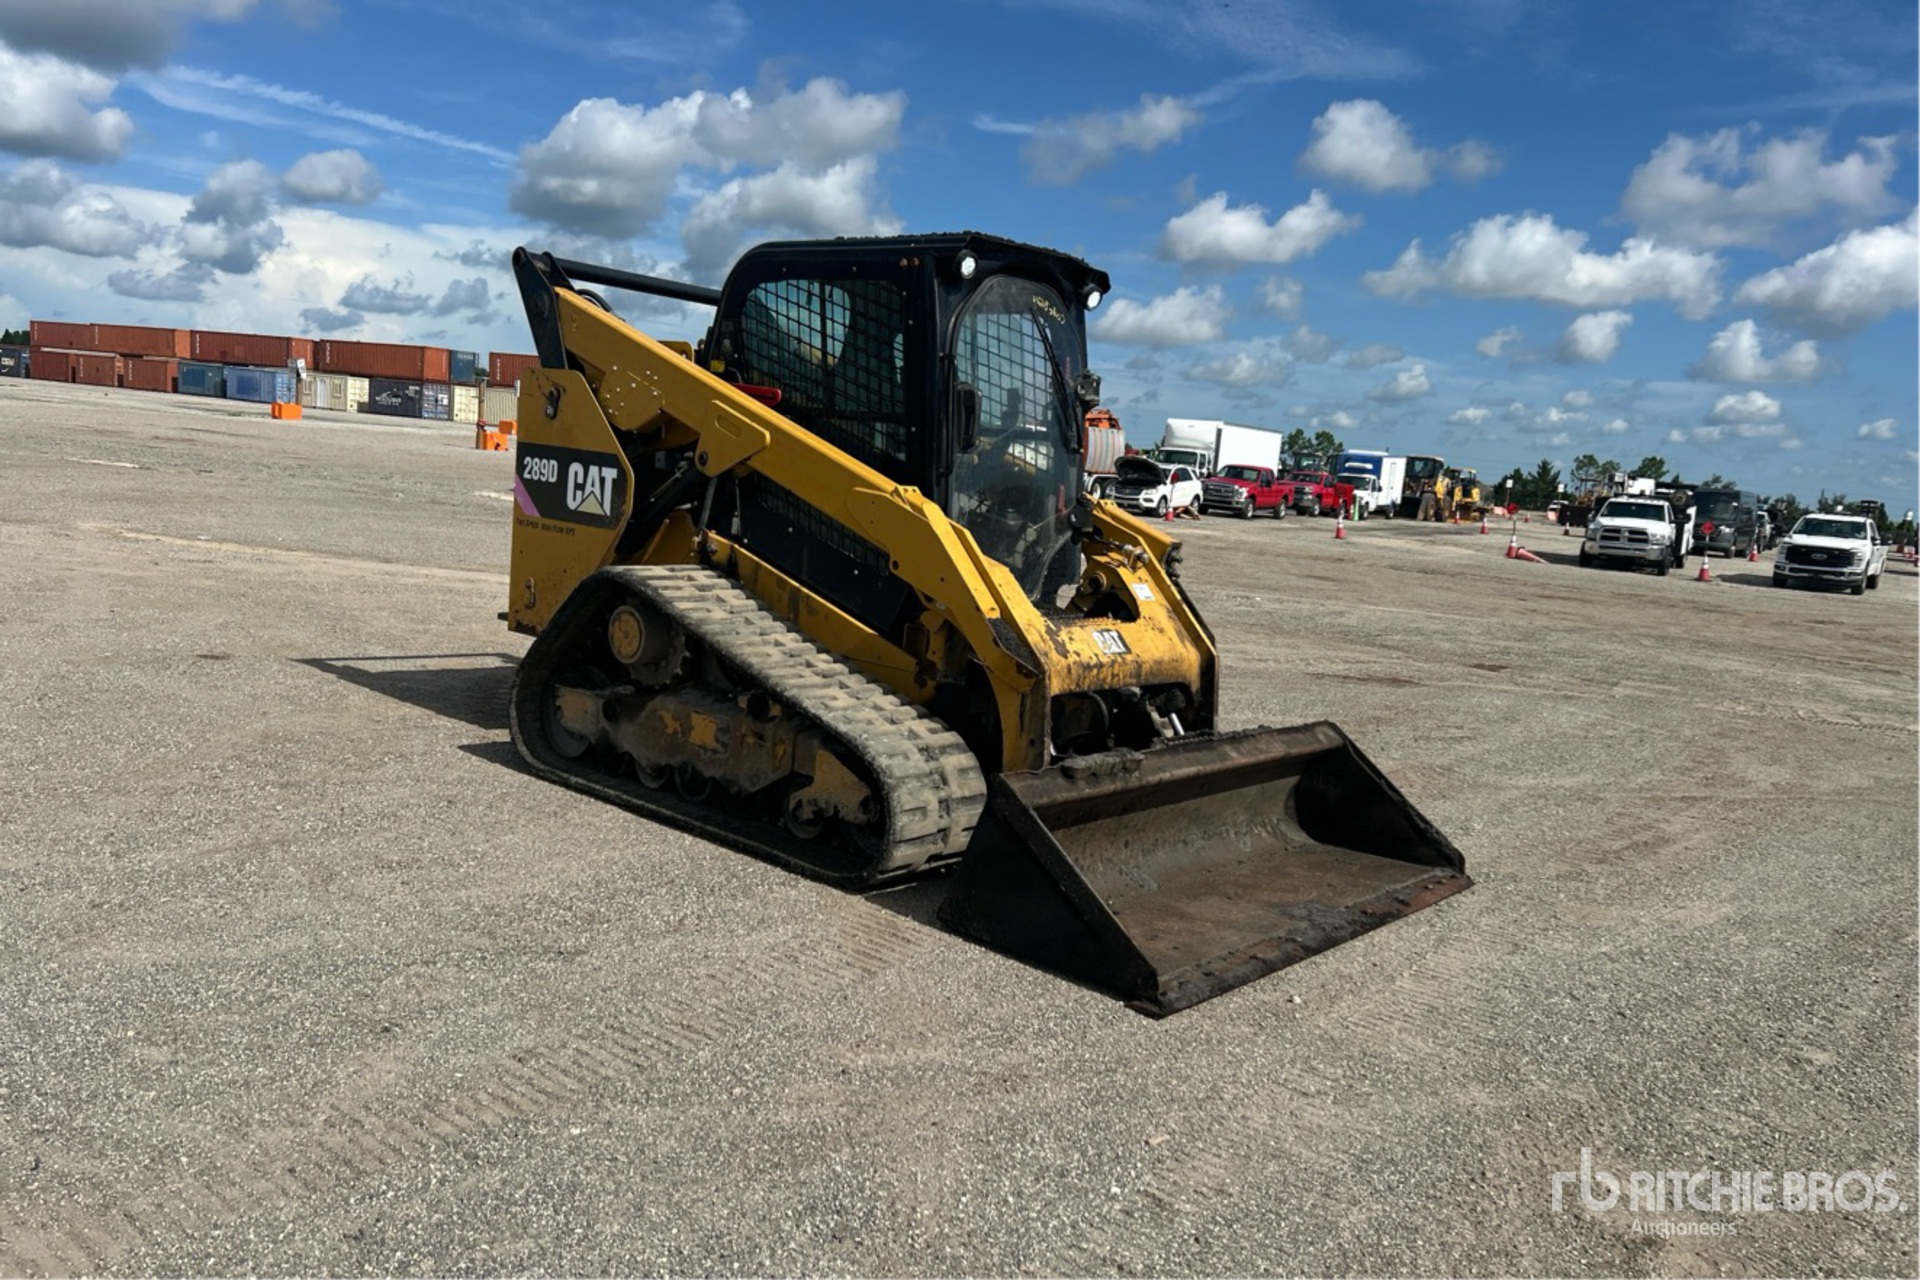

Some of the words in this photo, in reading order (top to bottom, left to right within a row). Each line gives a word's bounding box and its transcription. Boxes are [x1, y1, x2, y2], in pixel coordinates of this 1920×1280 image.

[523, 456, 558, 483] 289D
[566, 461, 618, 517] CAT
[1091, 630, 1127, 654] CAT
